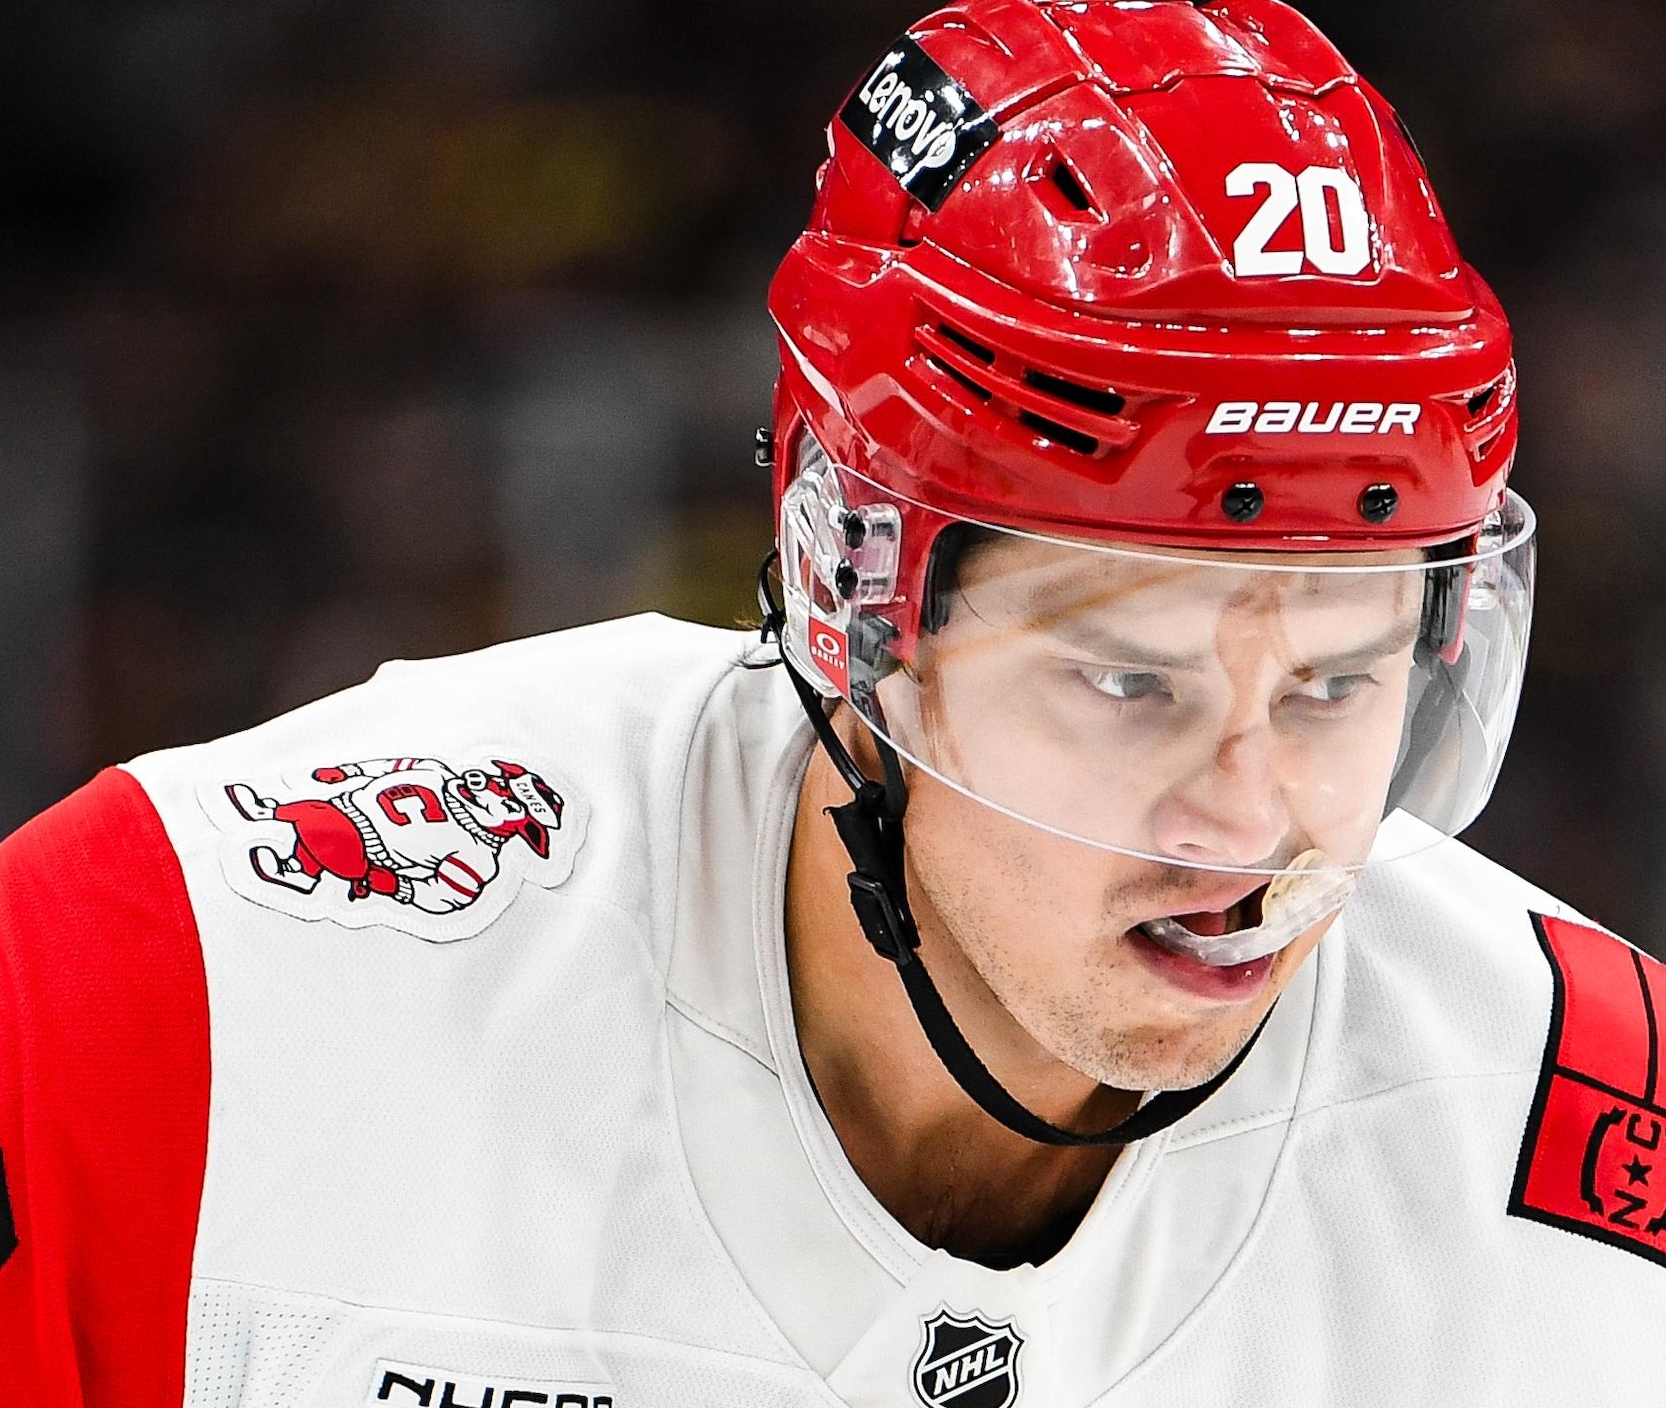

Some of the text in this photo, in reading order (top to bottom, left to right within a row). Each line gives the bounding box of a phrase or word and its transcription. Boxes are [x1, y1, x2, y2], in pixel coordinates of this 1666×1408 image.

[859, 51, 957, 168] Lenovo
[1225, 161, 1371, 277] 20
[375, 783, 449, 827] C
[933, 1343, 1005, 1396] NHL
